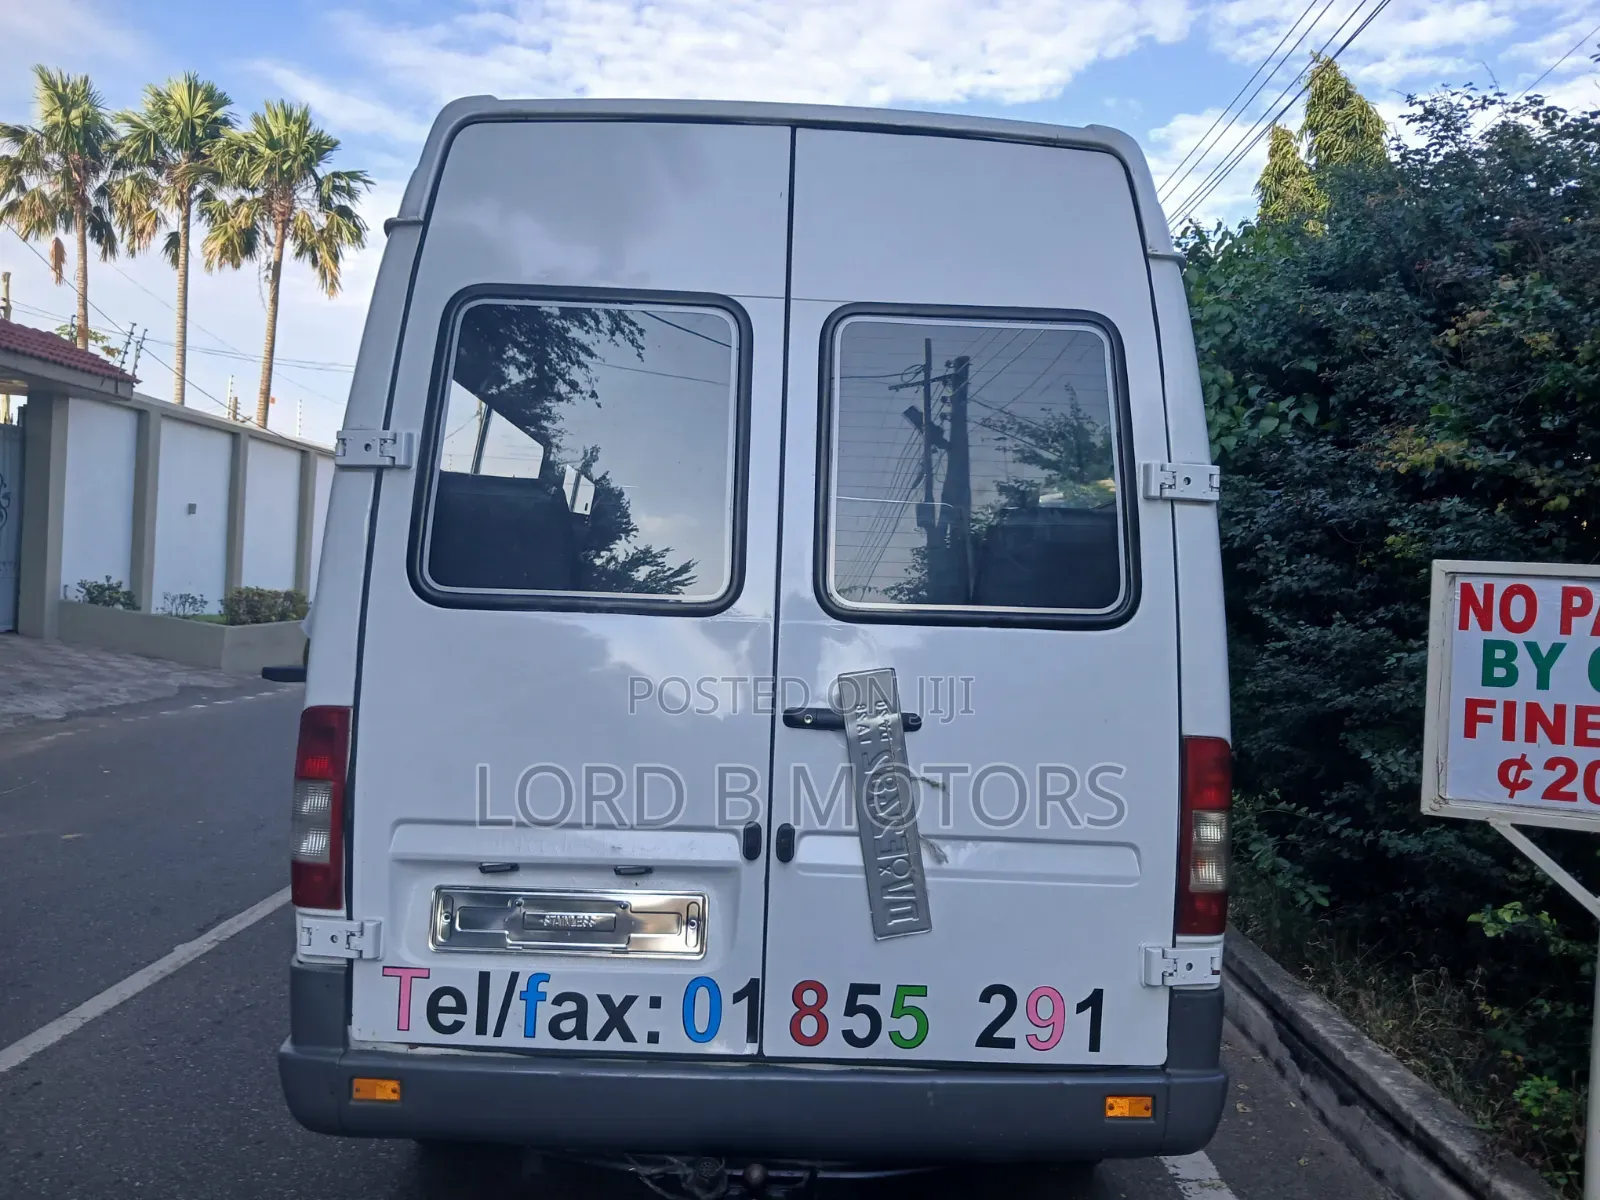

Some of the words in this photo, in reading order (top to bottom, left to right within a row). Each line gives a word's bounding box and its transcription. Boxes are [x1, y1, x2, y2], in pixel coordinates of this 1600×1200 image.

[1458, 582, 1538, 634] NO
[1559, 585, 1600, 637] P
[1481, 639, 1567, 690] BY
[1463, 697, 1600, 749] FINE
[382, 966, 662, 1044] Tel/fax:
[681, 975, 761, 1044] 01
[789, 979, 930, 1049] 855
[975, 983, 1104, 1053] 291
